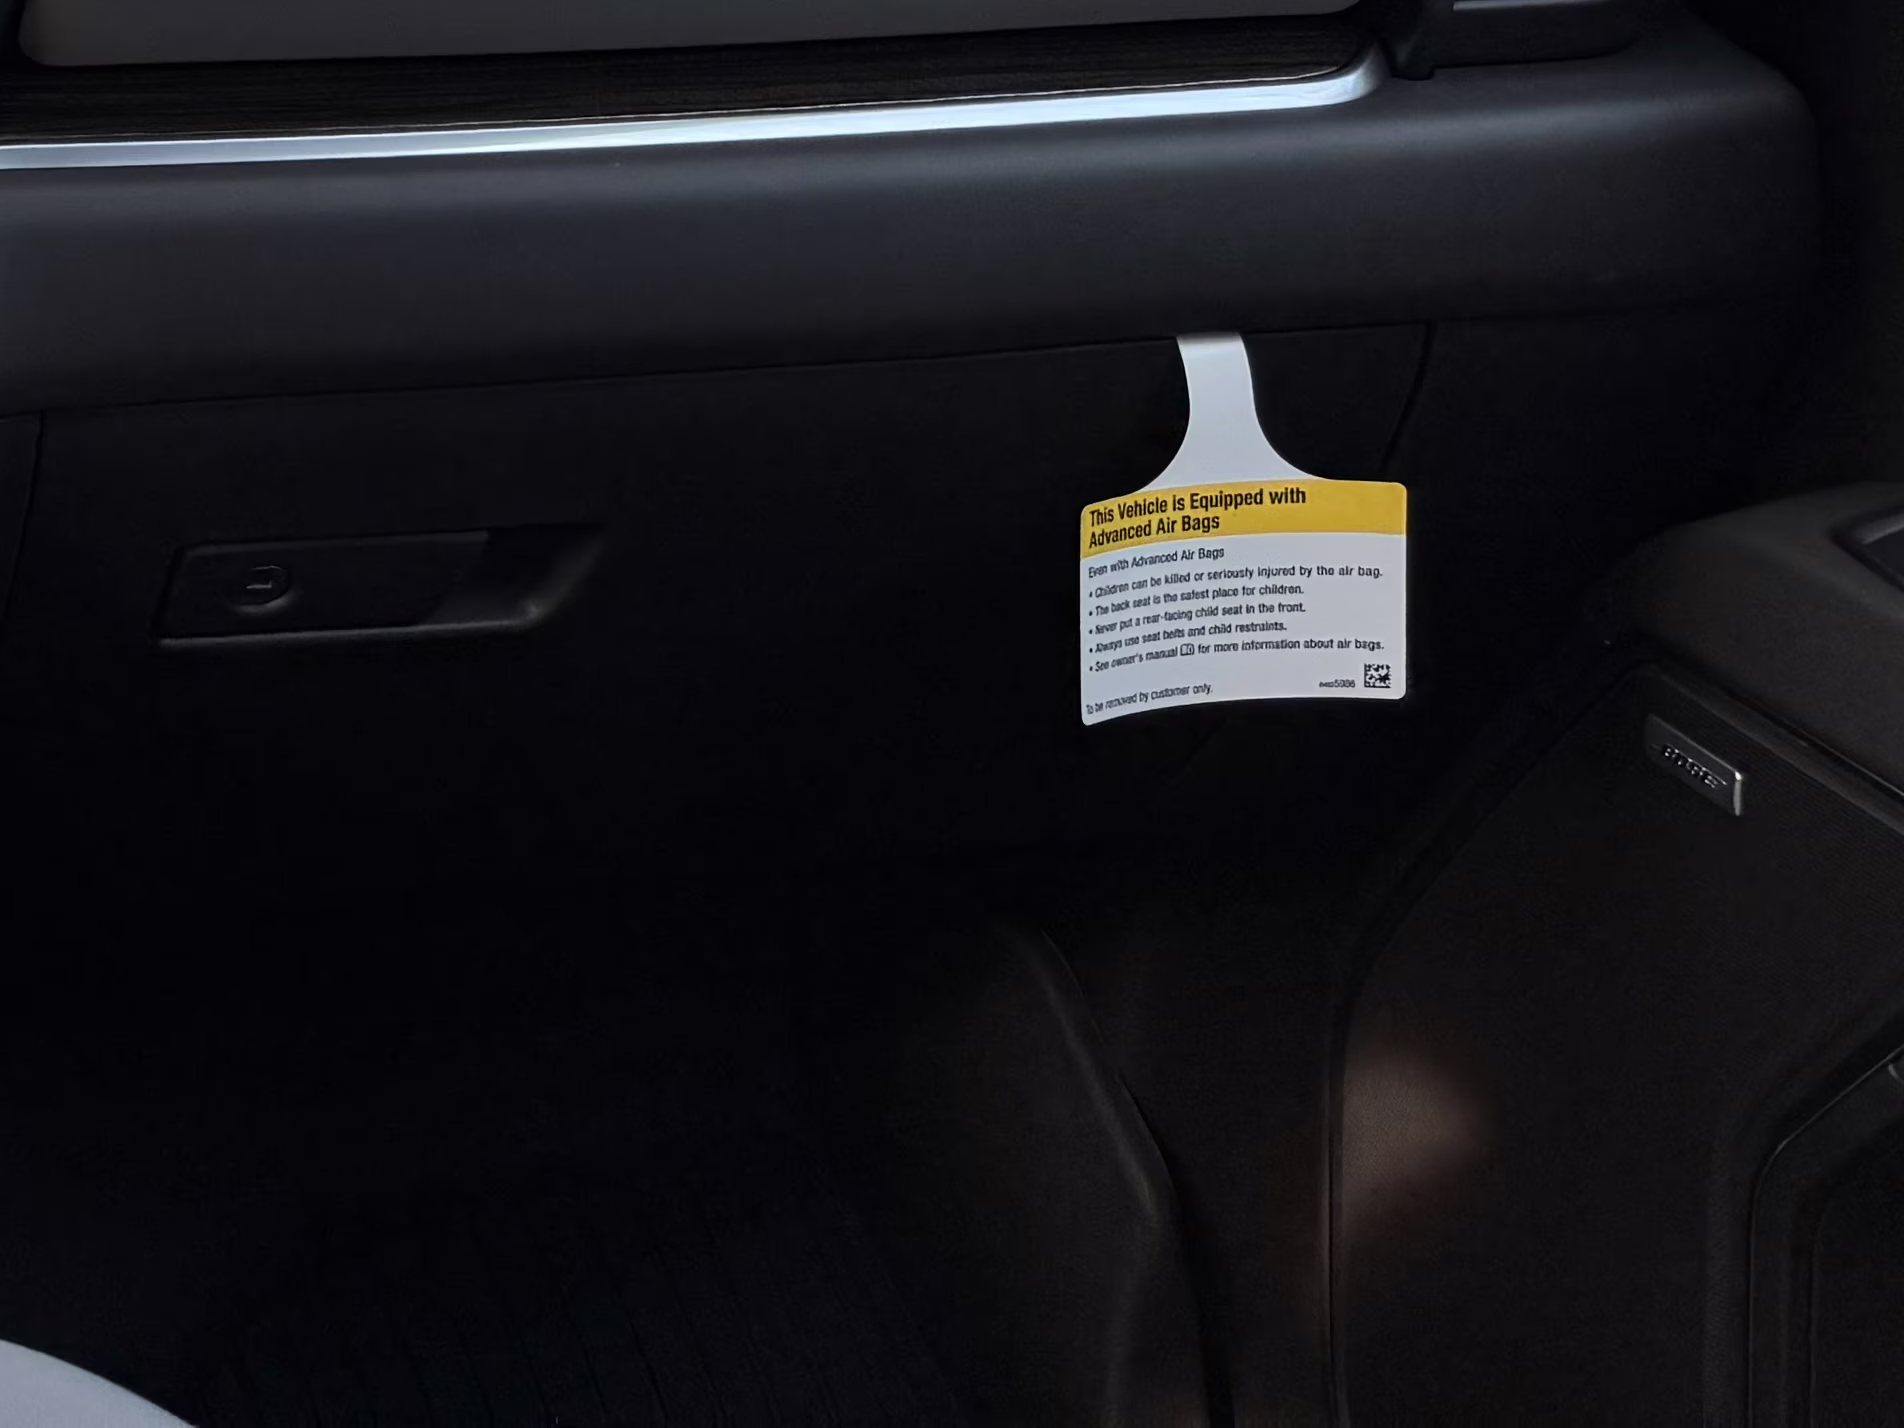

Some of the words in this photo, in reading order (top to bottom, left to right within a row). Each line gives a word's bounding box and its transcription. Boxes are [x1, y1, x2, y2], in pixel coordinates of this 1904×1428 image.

[1089, 508, 1114, 527] This
[1117, 498, 1167, 520] Vehicle
[1189, 488, 1263, 513] Equipped
[1269, 487, 1307, 505] with
[1089, 523, 1152, 549] Advanced
[1156, 518, 1177, 534] Air
[1182, 514, 1220, 533] Bags
[1088, 565, 1108, 578] Even
[1110, 559, 1129, 572] with
[1131, 550, 1177, 568] Advanced
[1181, 549, 1195, 561] Air
[1198, 547, 1224, 560] Bags
[1094, 582, 1129, 598] Children
[1131, 578, 1148, 589] can
[1150, 575, 1162, 587] be
[1164, 571, 1190, 584] killed
[1194, 571, 1204, 581] or
[1207, 566, 1254, 581] seriously
[1257, 566, 1296, 579] injured
[1299, 566, 1313, 578] by
[1316, 566, 1334, 576] the
[1338, 566, 1354, 576] air
[1357, 566, 1383, 579] bag.
[1163, 592, 1177, 604] the
[1180, 589, 1209, 602] safest
[1212, 586, 1239, 599] place
[1242, 586, 1255, 596] for
[1259, 584, 1304, 595] children.
[1195, 605, 1219, 618] child
[1221, 603, 1242, 616] seat
[1246, 604, 1255, 614] in
[1258, 603, 1275, 613] the
[1278, 601, 1306, 613] front.
[1198, 642, 1210, 654] for
[1213, 641, 1239, 652] more
[1241, 639, 1300, 651] information
[1304, 638, 1334, 649] about
[1337, 638, 1352, 649] air
[1355, 639, 1385, 652] bags.
